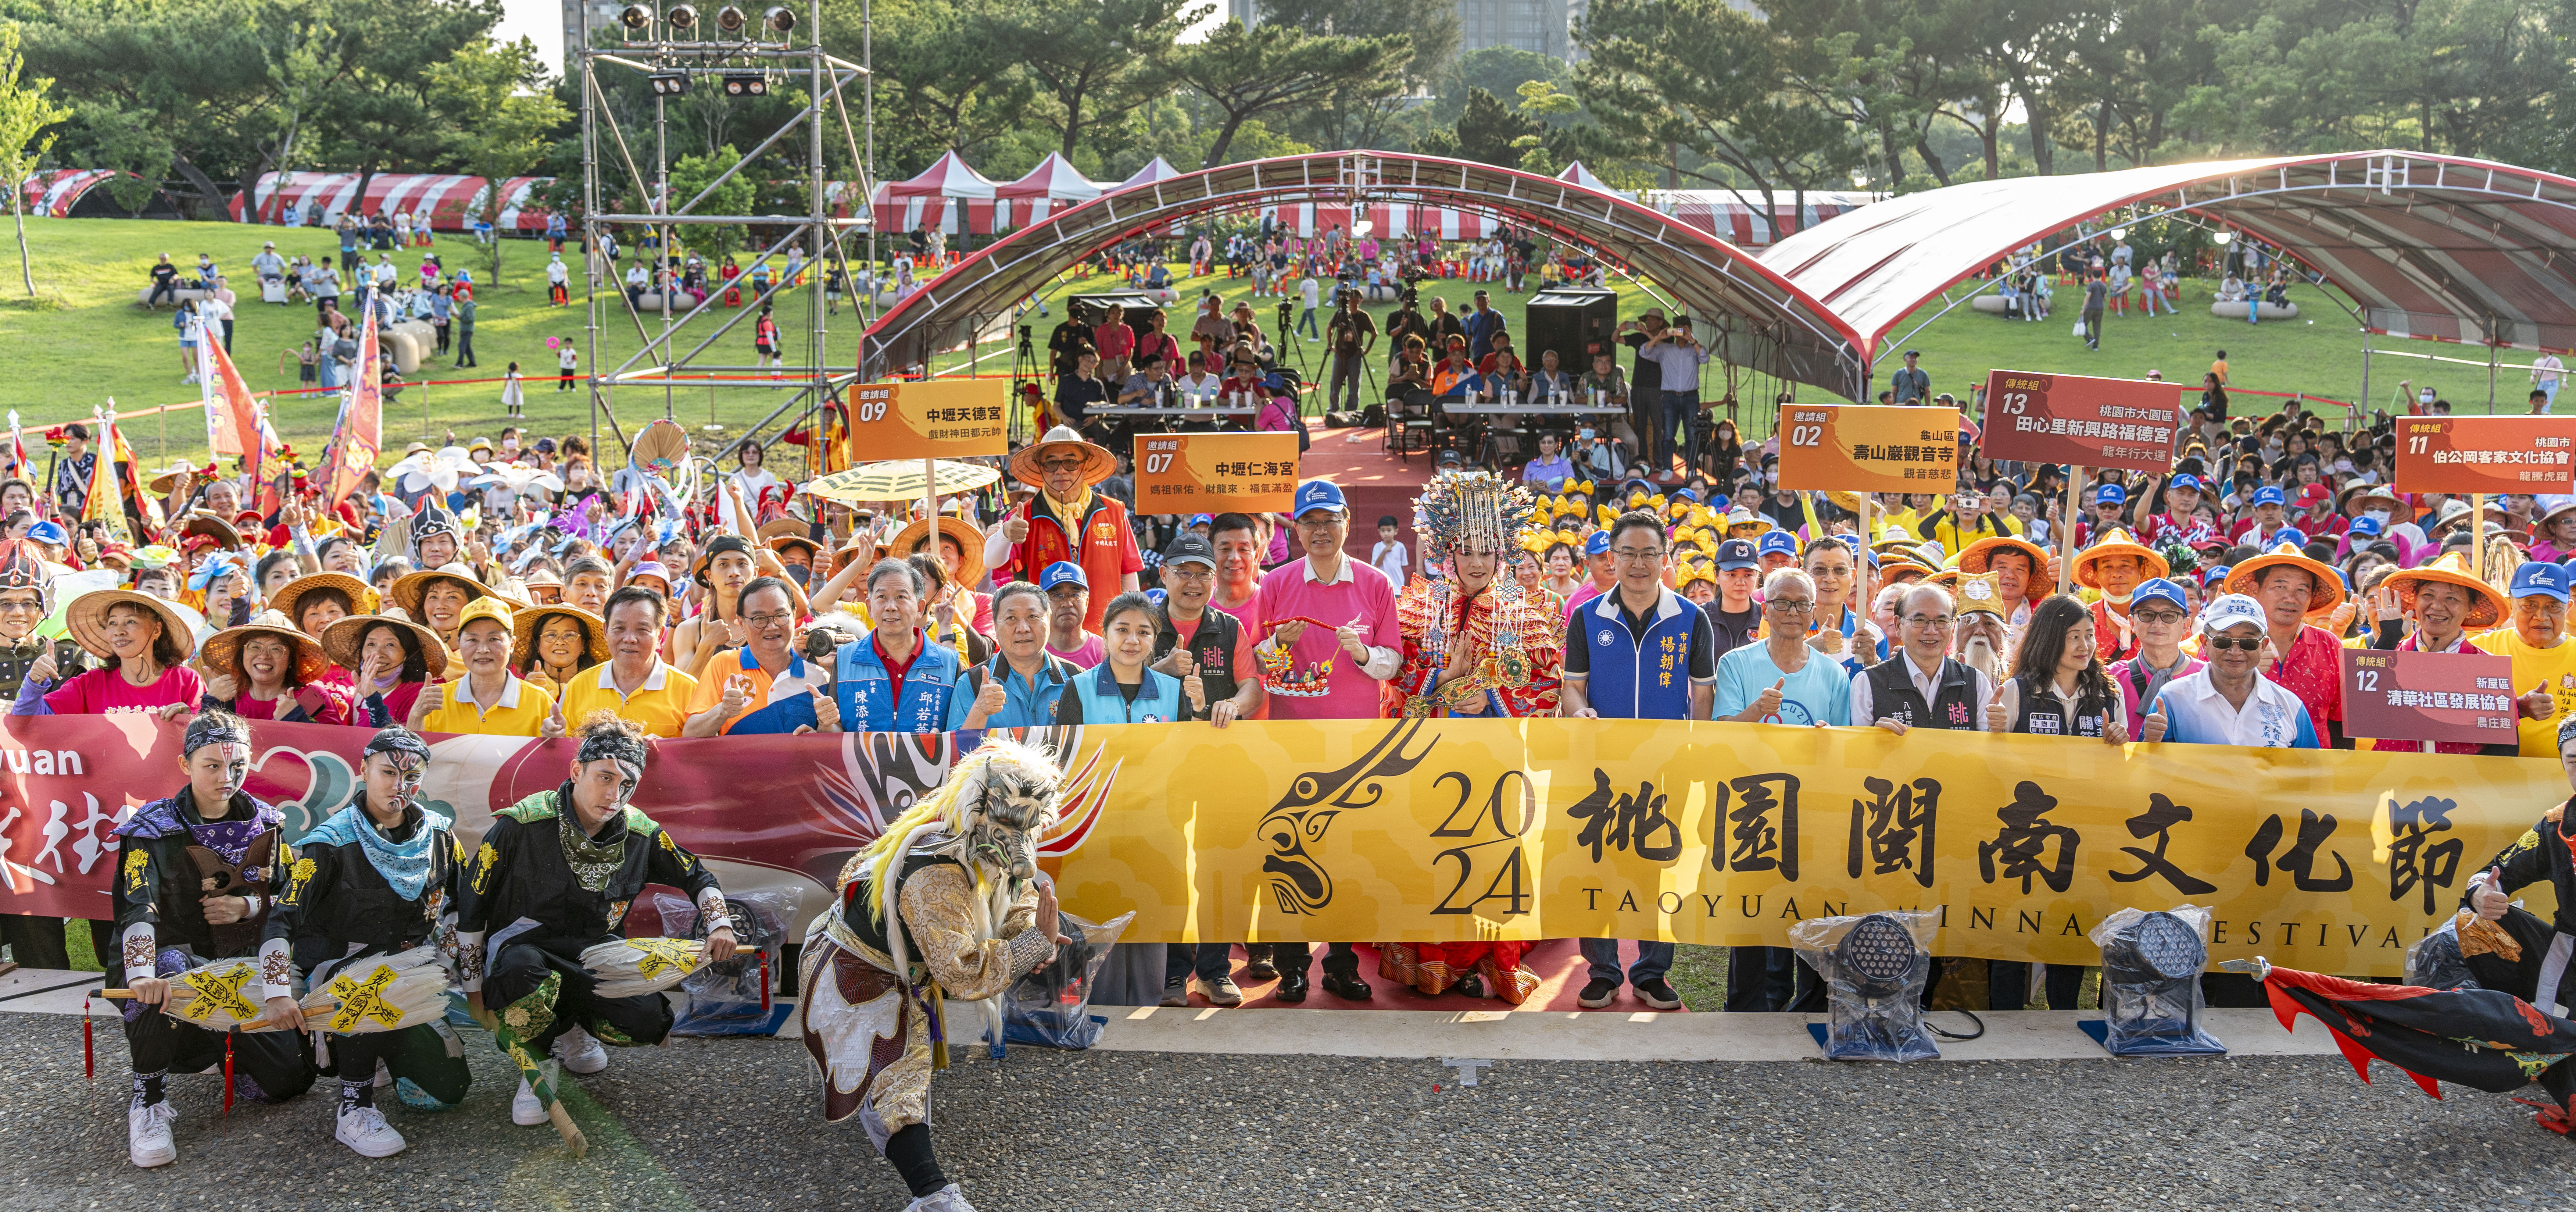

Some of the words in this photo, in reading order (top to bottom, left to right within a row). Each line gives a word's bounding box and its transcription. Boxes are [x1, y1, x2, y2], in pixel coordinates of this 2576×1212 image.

[2005, 378, 2040, 391] 傳統組
[860, 389, 889, 400] 邀請組
[861, 402, 887, 421] 09
[2002, 393, 2028, 414] 13
[927, 406, 1001, 423] 中壢天德宮
[1793, 411, 1826, 423] 邀請組
[2099, 404, 2174, 422] 桃園市大園區
[928, 427, 1001, 439] 戲財神田都元帥
[1792, 425, 1821, 446] 02
[1920, 430, 1954, 442] 龜山區
[2016, 416, 2171, 444] 田心里新興路福德宮
[2409, 424, 2441, 433] 傳統組
[1147, 441, 1177, 451] 邀請組
[2409, 436, 2429, 454] 11
[2535, 437, 2570, 448] 桃園市
[2101, 445, 2167, 462] 龍年行大運
[2433, 450, 2570, 465] 伯公岡客家文化協會
[1146, 453, 1173, 473] 07
[1216, 461, 1294, 477] 中壢仁海宮
[1903, 468, 1951, 480] 觀音慈悲
[2519, 471, 2568, 482] 龍騰虎躍
[1678, 631, 1688, 665] 市議員
[1659, 636, 1676, 688] 楊朝偉
[2356, 656, 2386, 667] 傳統組
[869, 681, 876, 693] 秘書
[2357, 670, 2378, 692] 12
[2476, 677, 2509, 689] 新屋區
[2386, 689, 2511, 712] 清華社區發展協會
[855, 689, 869, 732] 陳添發
[914, 691, 933, 733] 邱若華
[1904, 702, 1913, 727] 八德區
[2477, 716, 2511, 729] 農庄趣
[0, 749, 83, 775] uan
[1567, 767, 2464, 916] 桃園閩南文化節
[1582, 888, 1847, 920] TAOYUAN
